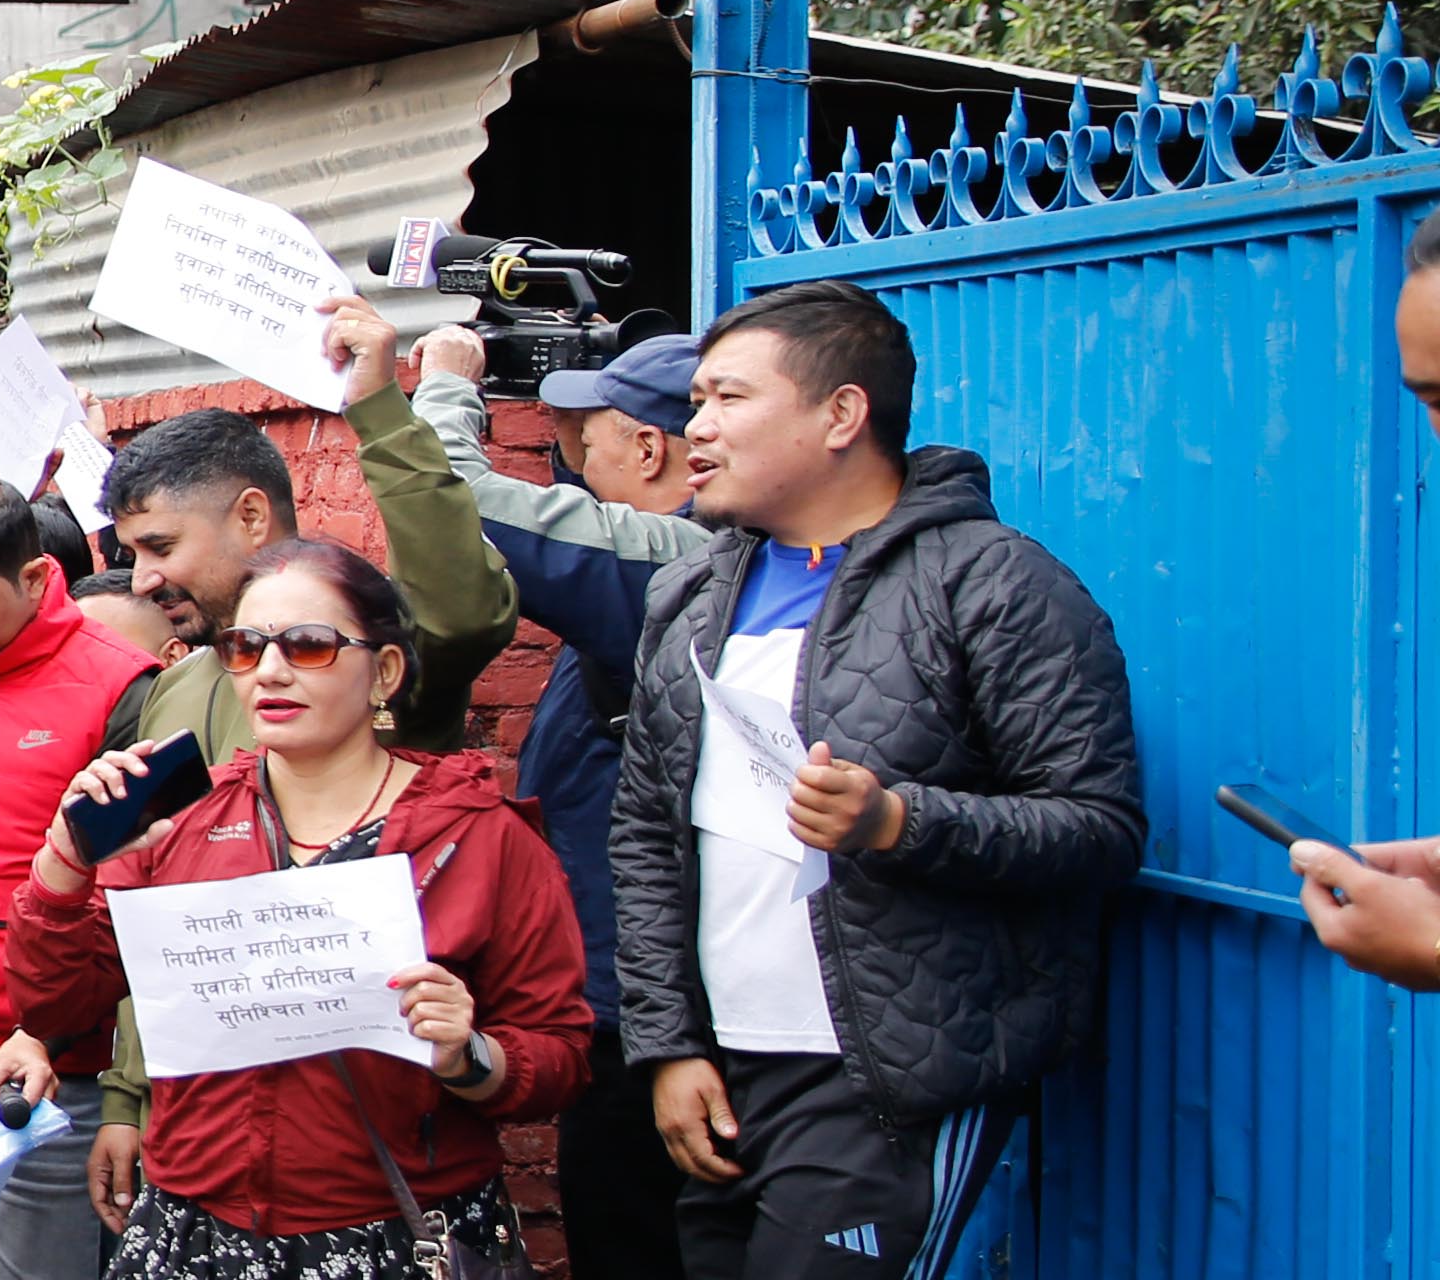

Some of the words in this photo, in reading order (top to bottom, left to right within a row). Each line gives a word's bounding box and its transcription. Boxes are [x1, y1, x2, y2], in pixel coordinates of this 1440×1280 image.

[401, 221, 429, 283] NAN
[183, 909, 244, 935] नेपाली
[162, 945, 237, 968] नियमित
[360, 930, 373, 947] र
[190, 972, 252, 1003] युवाको
[214, 1002, 306, 1030] सुनिश्चित
